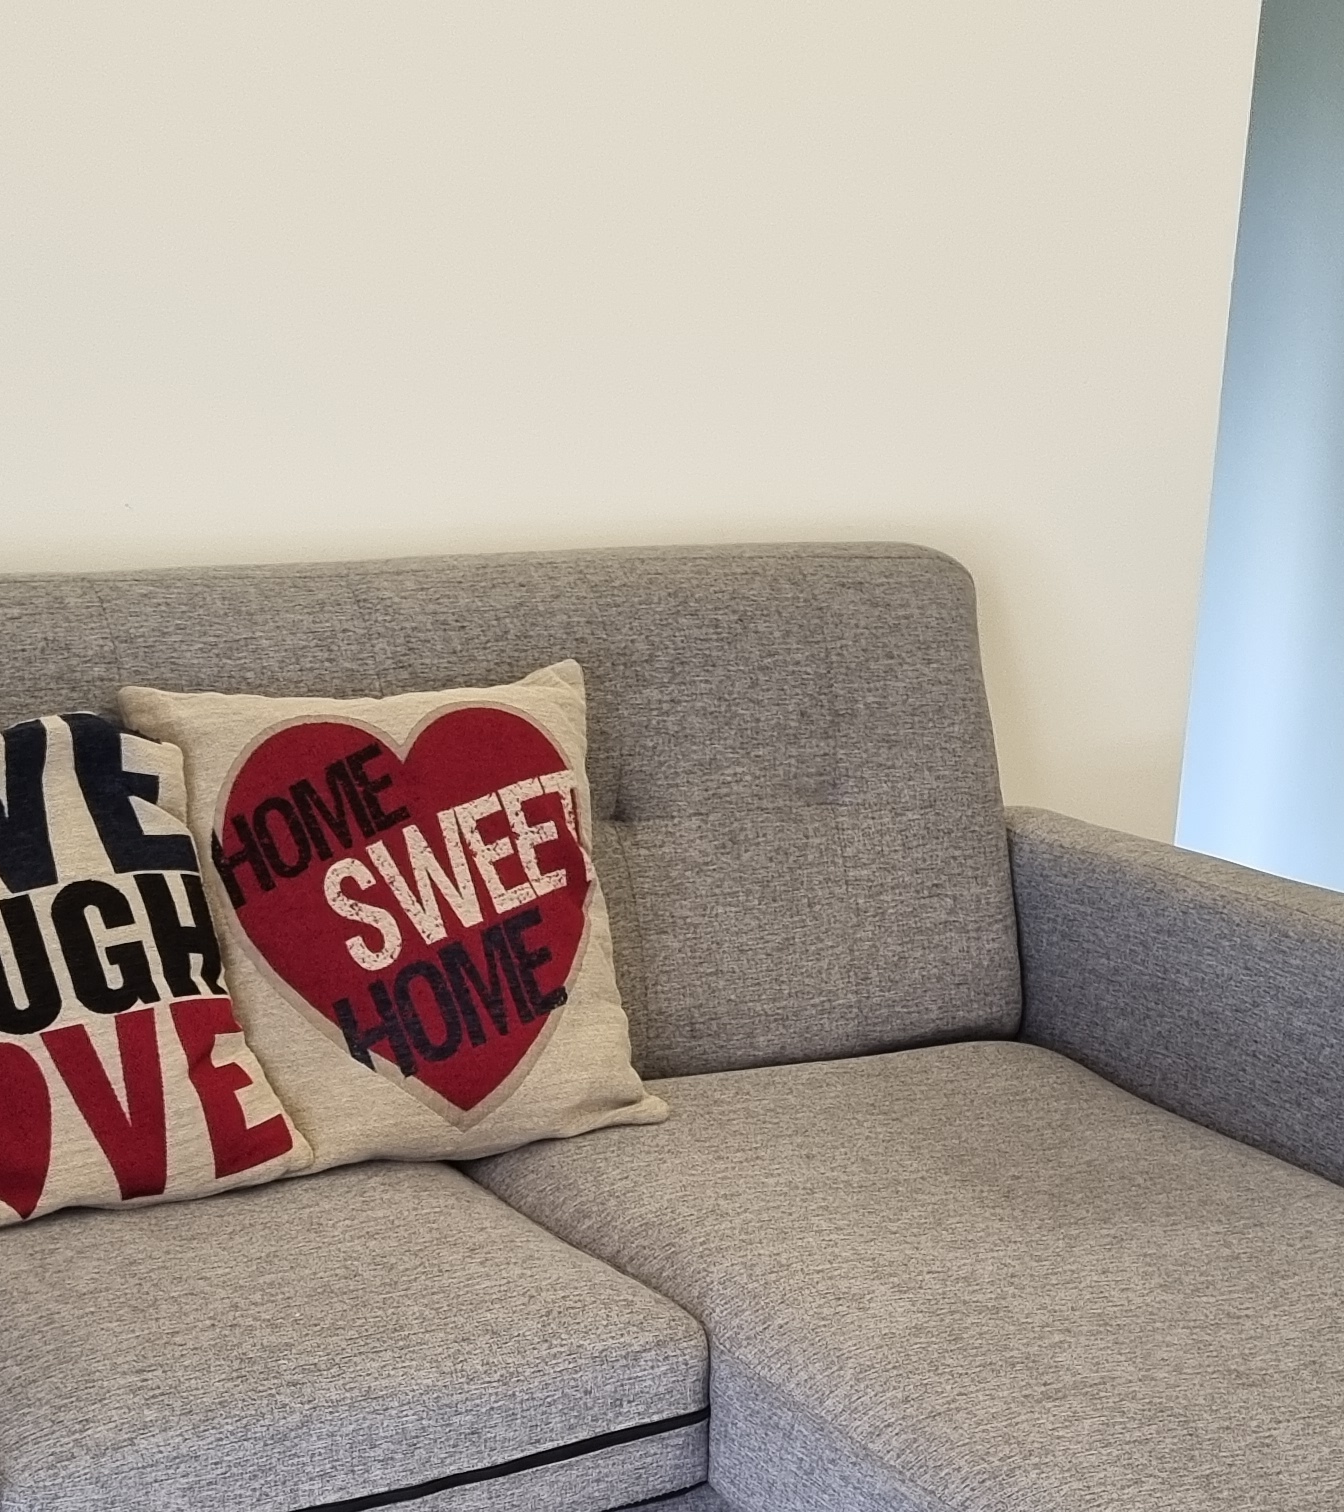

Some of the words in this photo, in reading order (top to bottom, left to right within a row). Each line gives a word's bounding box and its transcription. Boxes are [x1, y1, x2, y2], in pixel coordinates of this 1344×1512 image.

[211, 743, 411, 910] HOME
[323, 769, 594, 972] SWEET
[331, 905, 568, 1078] HOME
